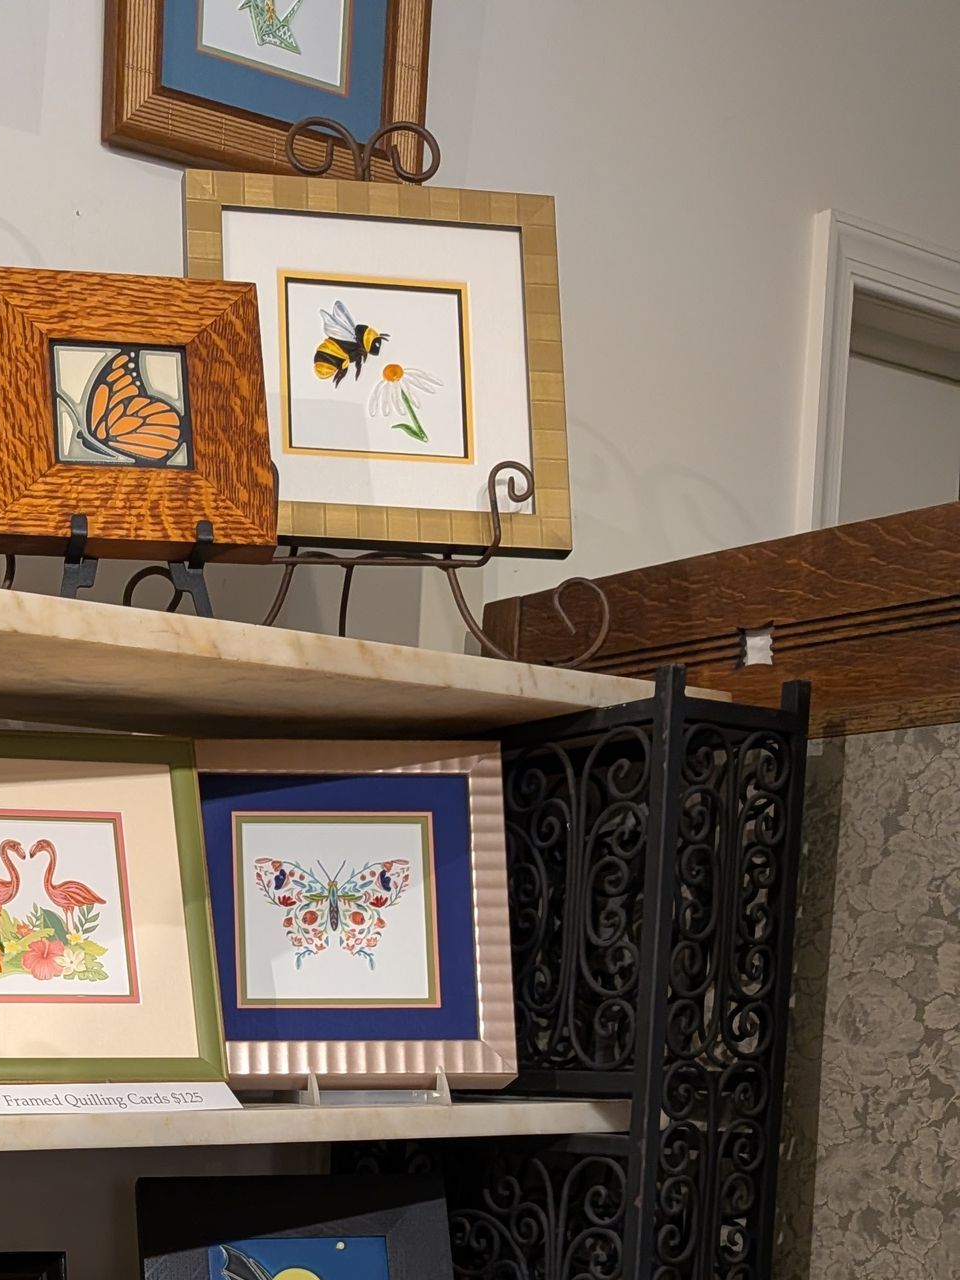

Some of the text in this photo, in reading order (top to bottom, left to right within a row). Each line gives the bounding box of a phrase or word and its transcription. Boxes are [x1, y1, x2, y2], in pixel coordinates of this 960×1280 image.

[1, 1091, 204, 1110] Framed Quilling Cards $125
